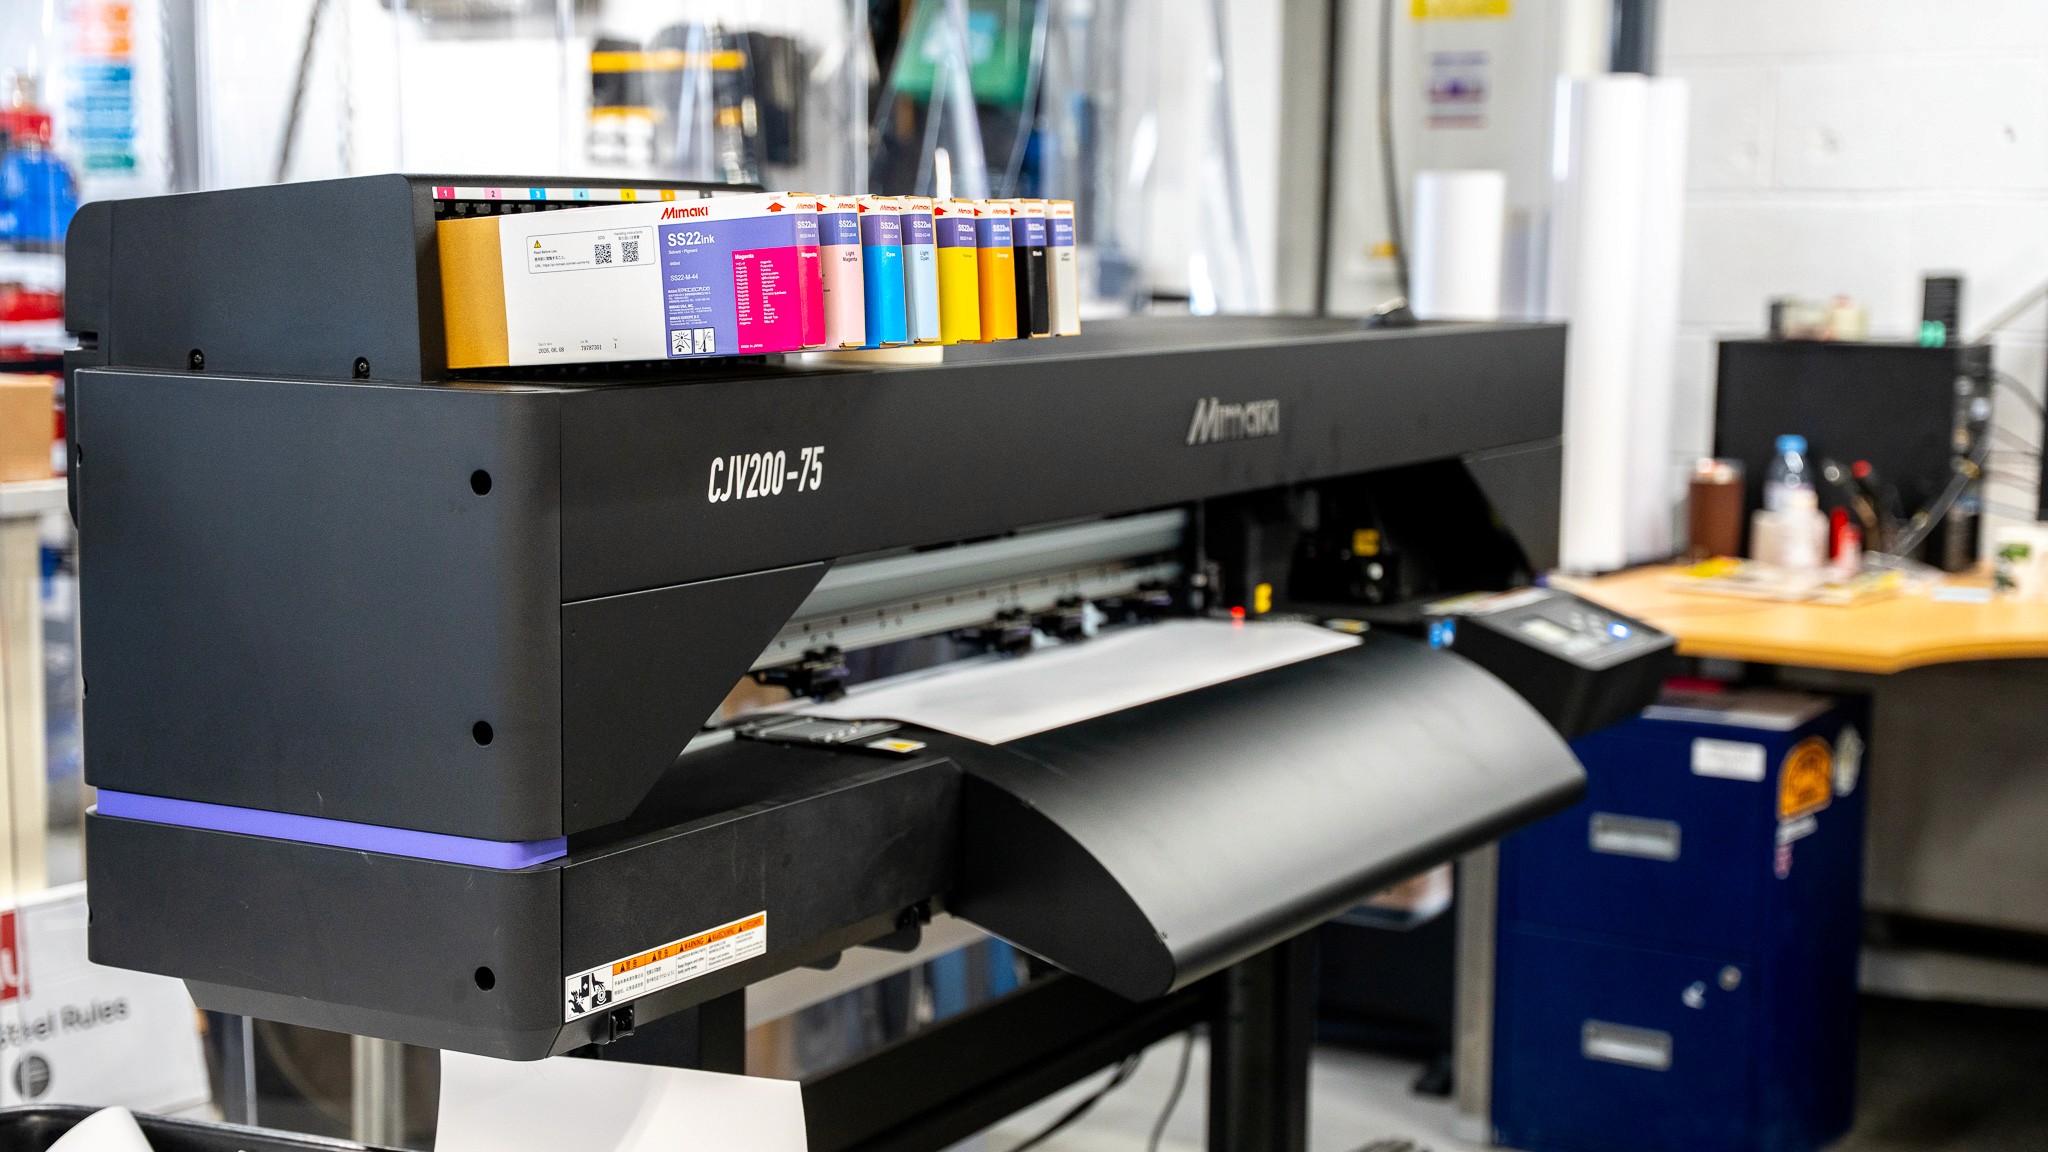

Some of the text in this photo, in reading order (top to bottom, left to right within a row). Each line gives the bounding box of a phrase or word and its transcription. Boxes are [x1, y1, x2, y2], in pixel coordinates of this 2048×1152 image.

[661, 206, 709, 220] Mimaki
[797, 220, 817, 229] SS22ink
[838, 219, 857, 228] SS22ink
[667, 231, 715, 247] SS22ink
[670, 273, 699, 281] SS22-M-44
[708, 446, 825, 503] CJV200-75
[684, 937, 705, 947] WARNING
